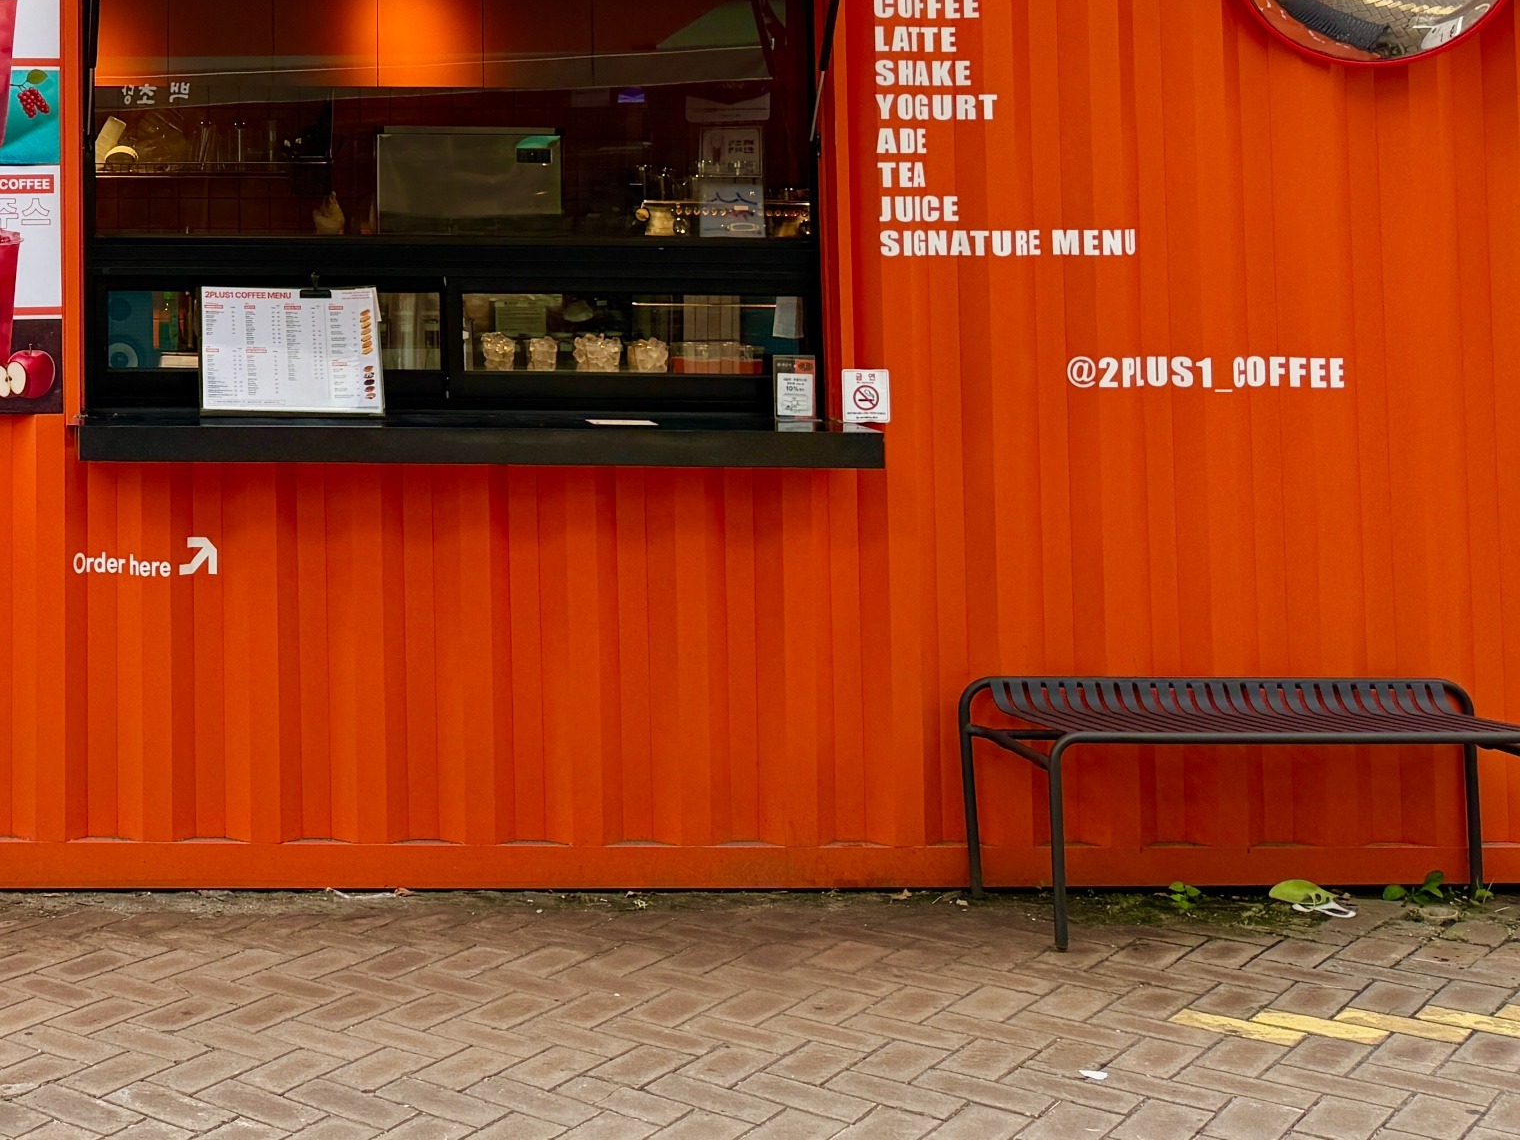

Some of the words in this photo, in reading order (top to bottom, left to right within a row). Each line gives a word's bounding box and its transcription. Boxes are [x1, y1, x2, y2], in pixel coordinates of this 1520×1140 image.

[874, 26, 957, 52] LATTE
[874, 60, 972, 87] SHAKE
[874, 93, 998, 121] YOGURT
[876, 128, 927, 154] ADE
[877, 162, 926, 188] TEA
[878, 195, 959, 222] JUICE
[879, 229, 1041, 257] SIGNATURE
[1052, 228, 1136, 256] MENU
[204, 291, 234, 299] 2PLUS1
[235, 291, 266, 299] COFFEE
[267, 291, 292, 300] MENU
[1067, 356, 1345, 393] @2PLUS1_COFFEE
[73, 551, 126, 575] Order
[129, 553, 171, 578] here
